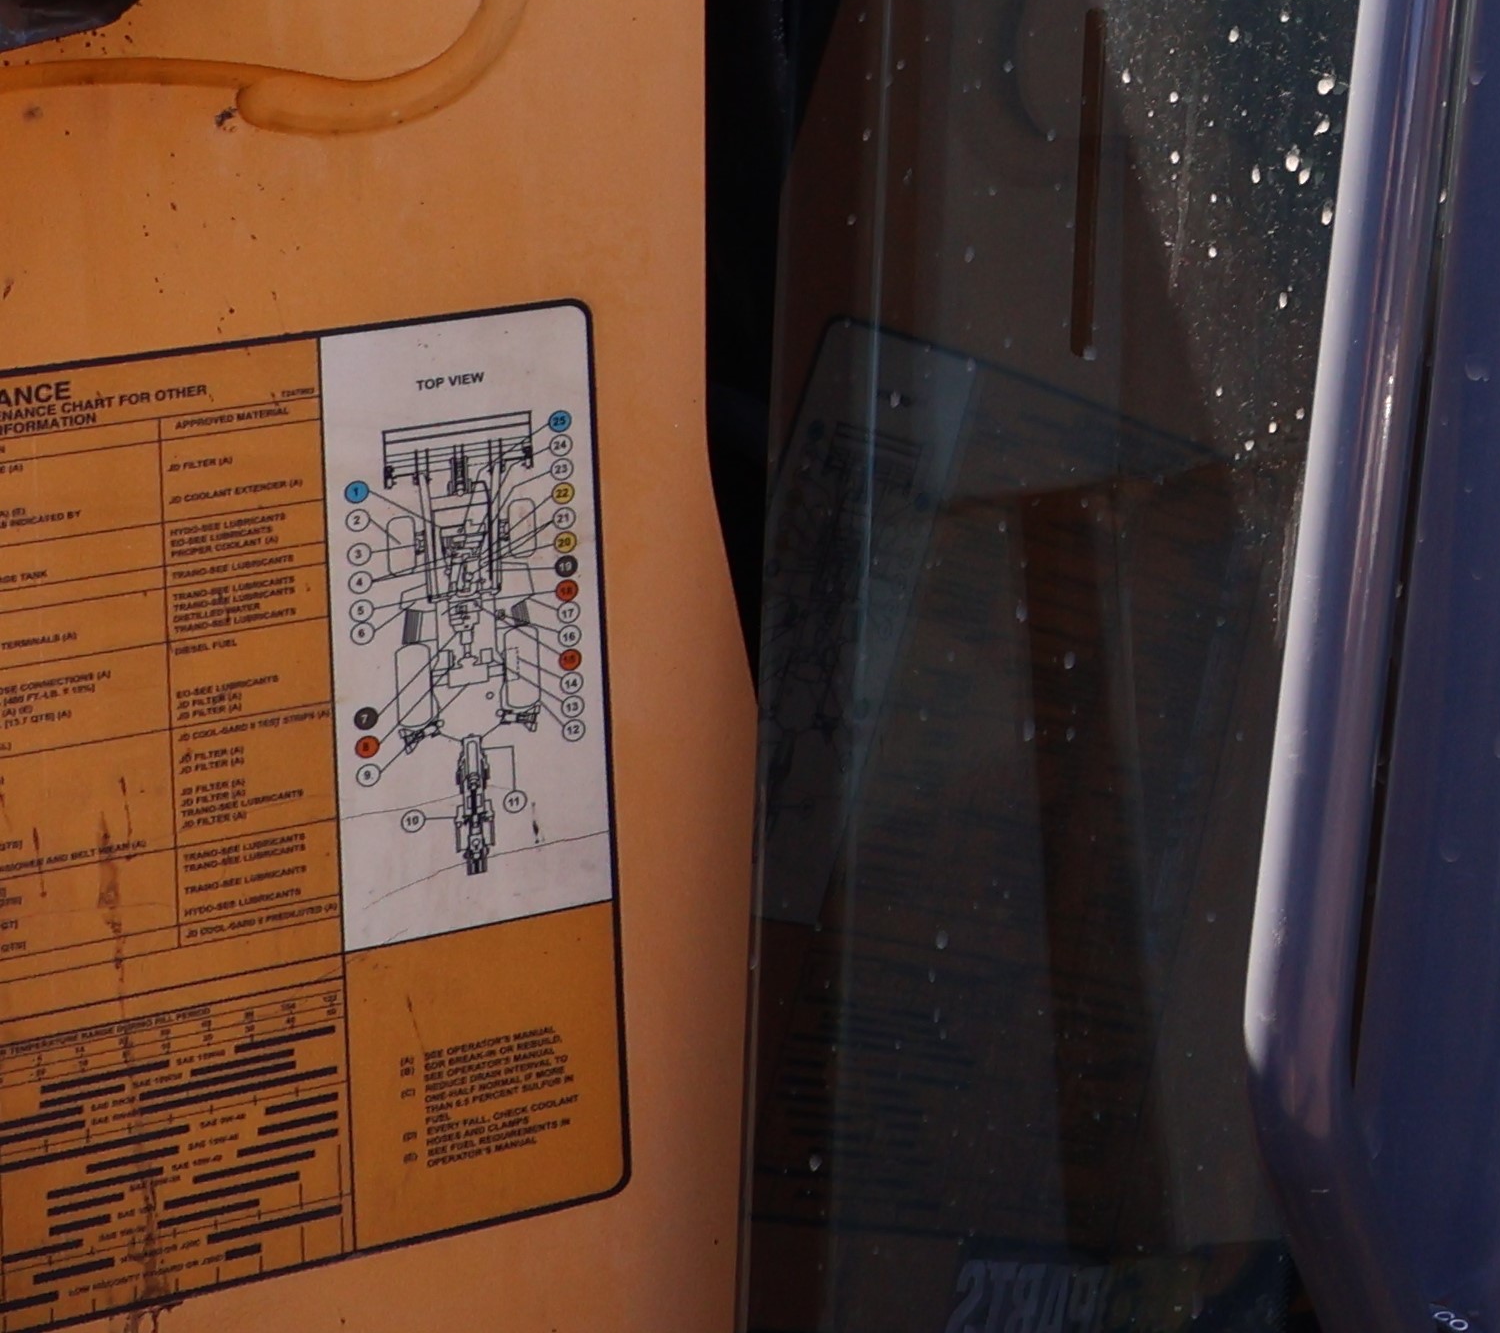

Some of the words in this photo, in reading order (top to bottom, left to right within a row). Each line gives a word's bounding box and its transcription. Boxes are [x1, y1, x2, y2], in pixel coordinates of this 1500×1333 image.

[417, 378, 444, 390] TOP
[448, 372, 485, 386] VIEW
[0, 403, 57, 422] NANCE
[61, 396, 114, 414] CHART
[119, 392, 150, 406] FOR
[155, 384, 207, 402] OTHER
[175, 413, 233, 429] APPROVED
[236, 407, 289, 422] MATERIAL
[553, 416, 565, 426] 25
[555, 441, 567, 450] 24
[555, 465, 567, 474] 23
[354, 488, 357, 496] 1
[556, 489, 568, 498] 22
[354, 516, 360, 524] 2
[557, 513, 569, 523] 21
[558, 538, 570, 547] 20
[355, 550, 362, 559] 3
[356, 578, 363, 587] 4
[357, 606, 364, 615] 5
[562, 608, 574, 618] 17
[563, 632, 575, 641] 16
[565, 678, 577, 688] 14
[567, 703, 578, 711] 13
[362, 714, 368, 723] 7
[567, 725, 580, 734] 12
[509, 797, 519, 806] 11
